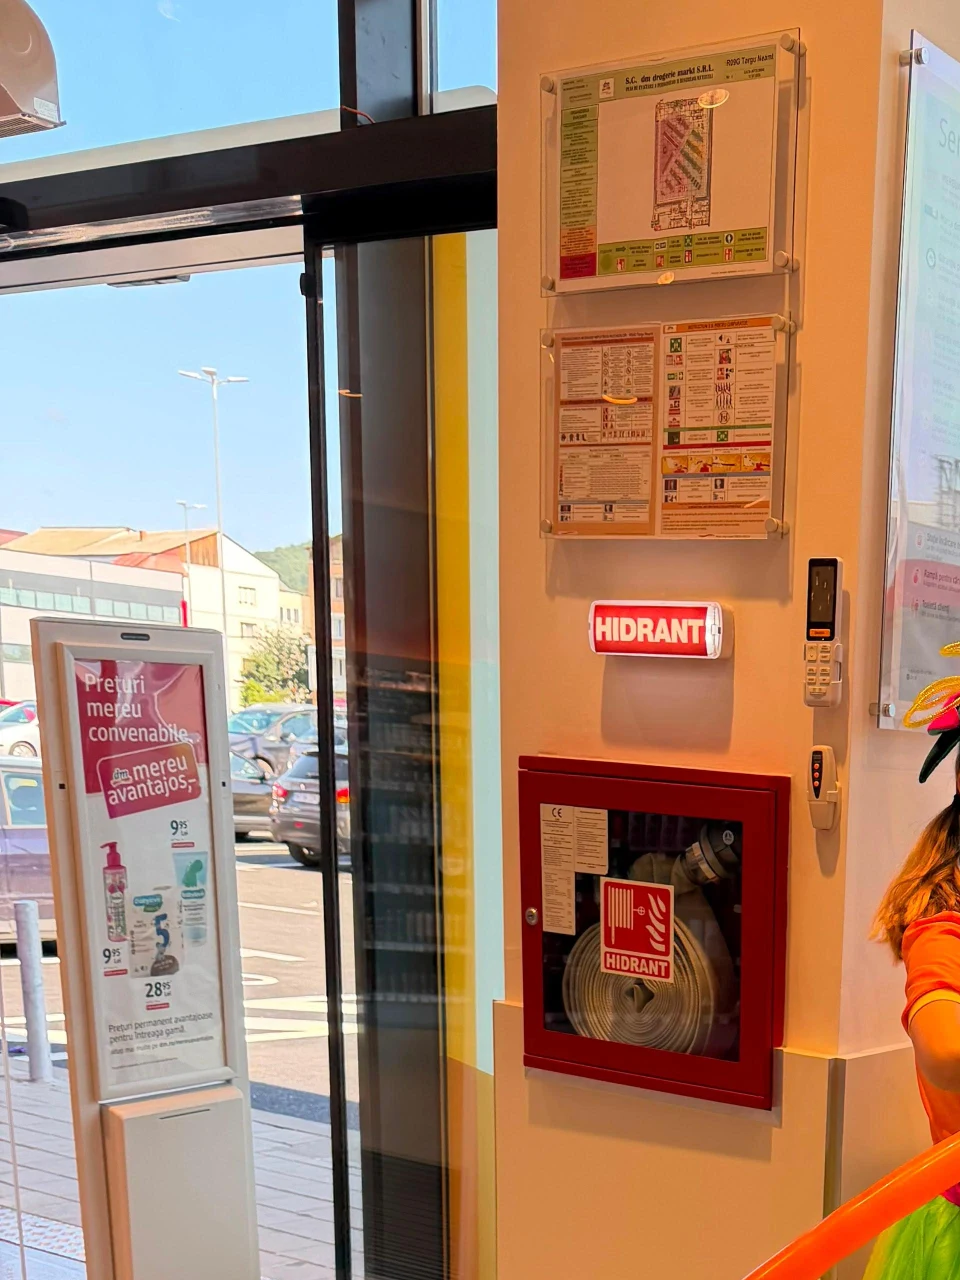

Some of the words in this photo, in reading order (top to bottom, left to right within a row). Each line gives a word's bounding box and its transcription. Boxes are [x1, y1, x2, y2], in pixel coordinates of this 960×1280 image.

[652, 71, 675, 81] drogerie
[595, 616, 704, 644] HIDRANT
[87, 702, 142, 718] mereu
[113, 768, 129, 780] dm
[133, 756, 187, 780] mereu
[605, 953, 668, 977] HIDRANT
[145, 982, 162, 998] 28
[135, 1018, 173, 1029] permanent
[110, 1034, 133, 1044] pentru
